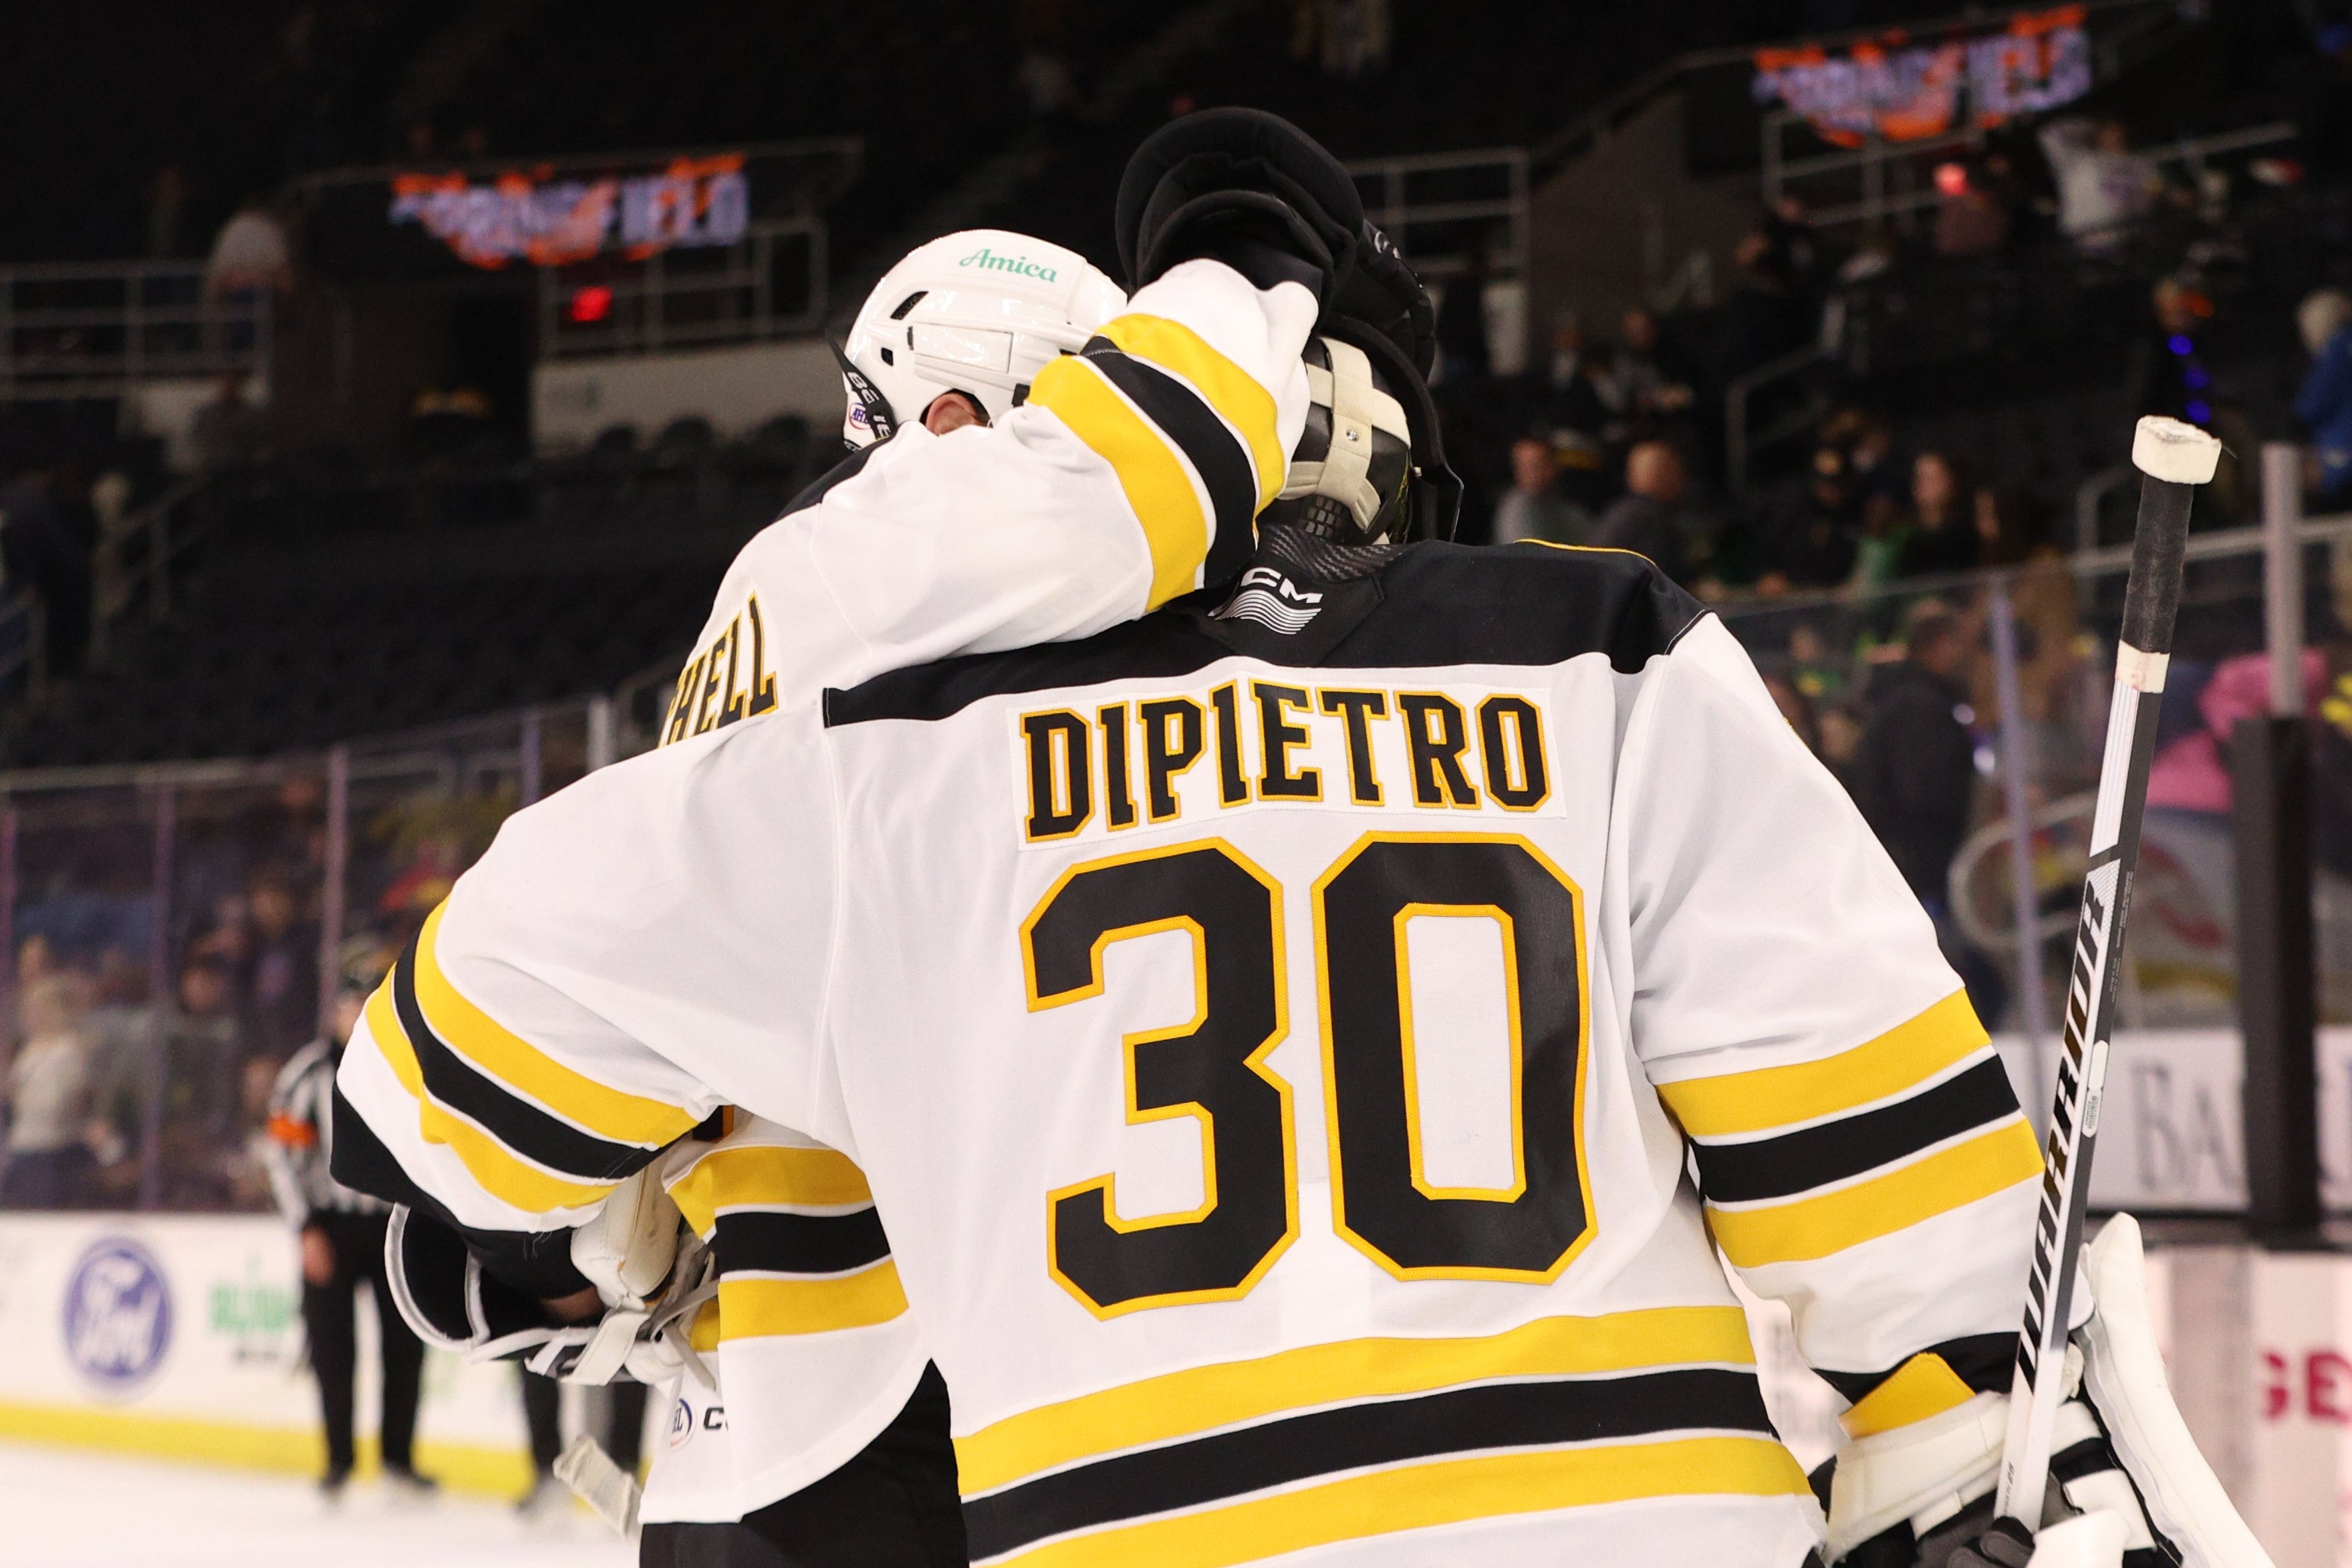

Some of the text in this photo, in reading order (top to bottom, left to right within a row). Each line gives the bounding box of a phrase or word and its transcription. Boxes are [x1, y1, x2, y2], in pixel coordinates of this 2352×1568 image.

[958, 248, 1057, 283] Amica
[1240, 565, 1324, 604] CM
[658, 590, 779, 749] HELL
[1019, 677, 1552, 843] DIPIETRO
[1019, 830, 1599, 1321] 30
[2016, 877, 2105, 1396] WARRIOR
